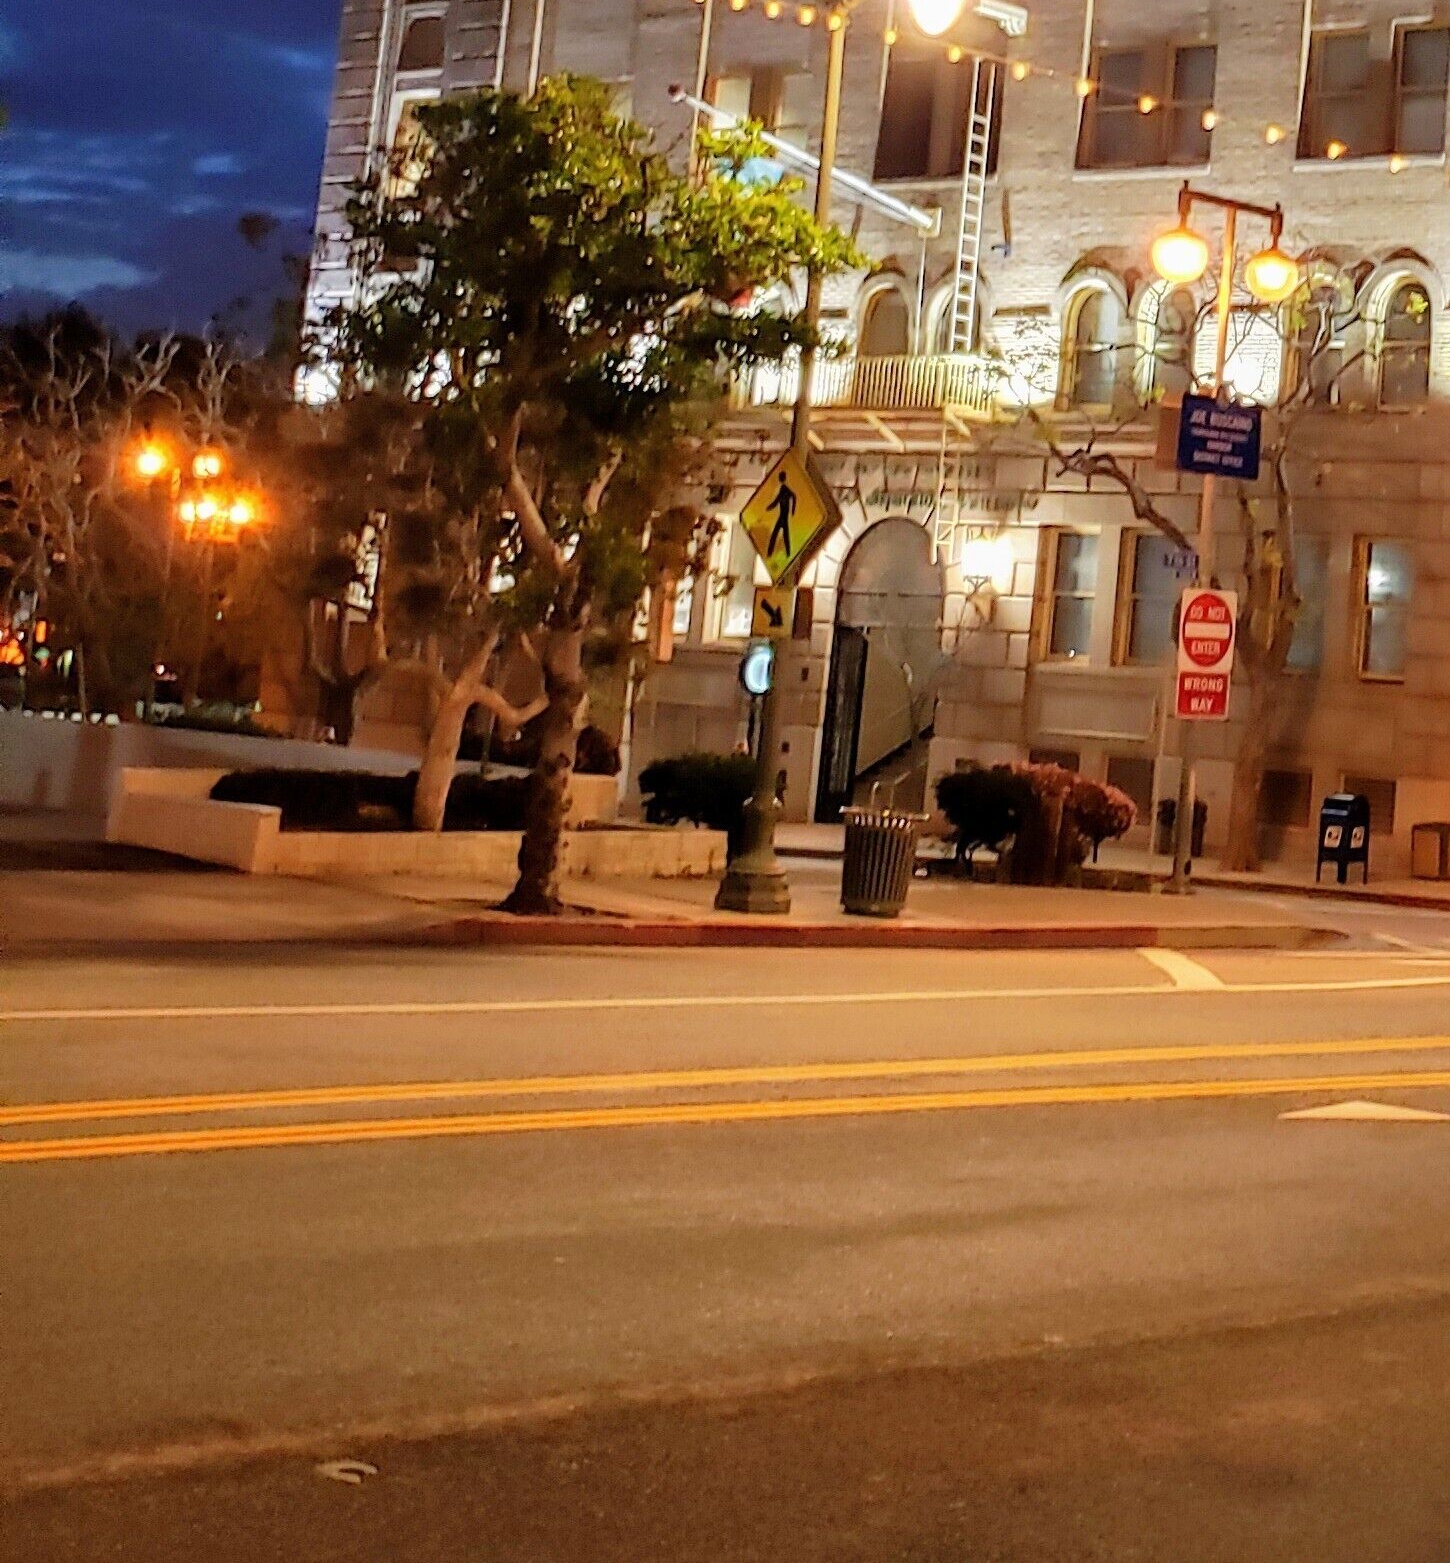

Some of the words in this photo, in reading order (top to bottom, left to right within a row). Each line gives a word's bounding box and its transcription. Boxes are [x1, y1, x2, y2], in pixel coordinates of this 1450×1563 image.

[1190, 604, 1203, 619] DO
[1208, 606, 1225, 621] NOT
[1191, 640, 1220, 655] ENTER
[1184, 677, 1223, 692] WRONG
[1191, 697, 1213, 712] WAY
